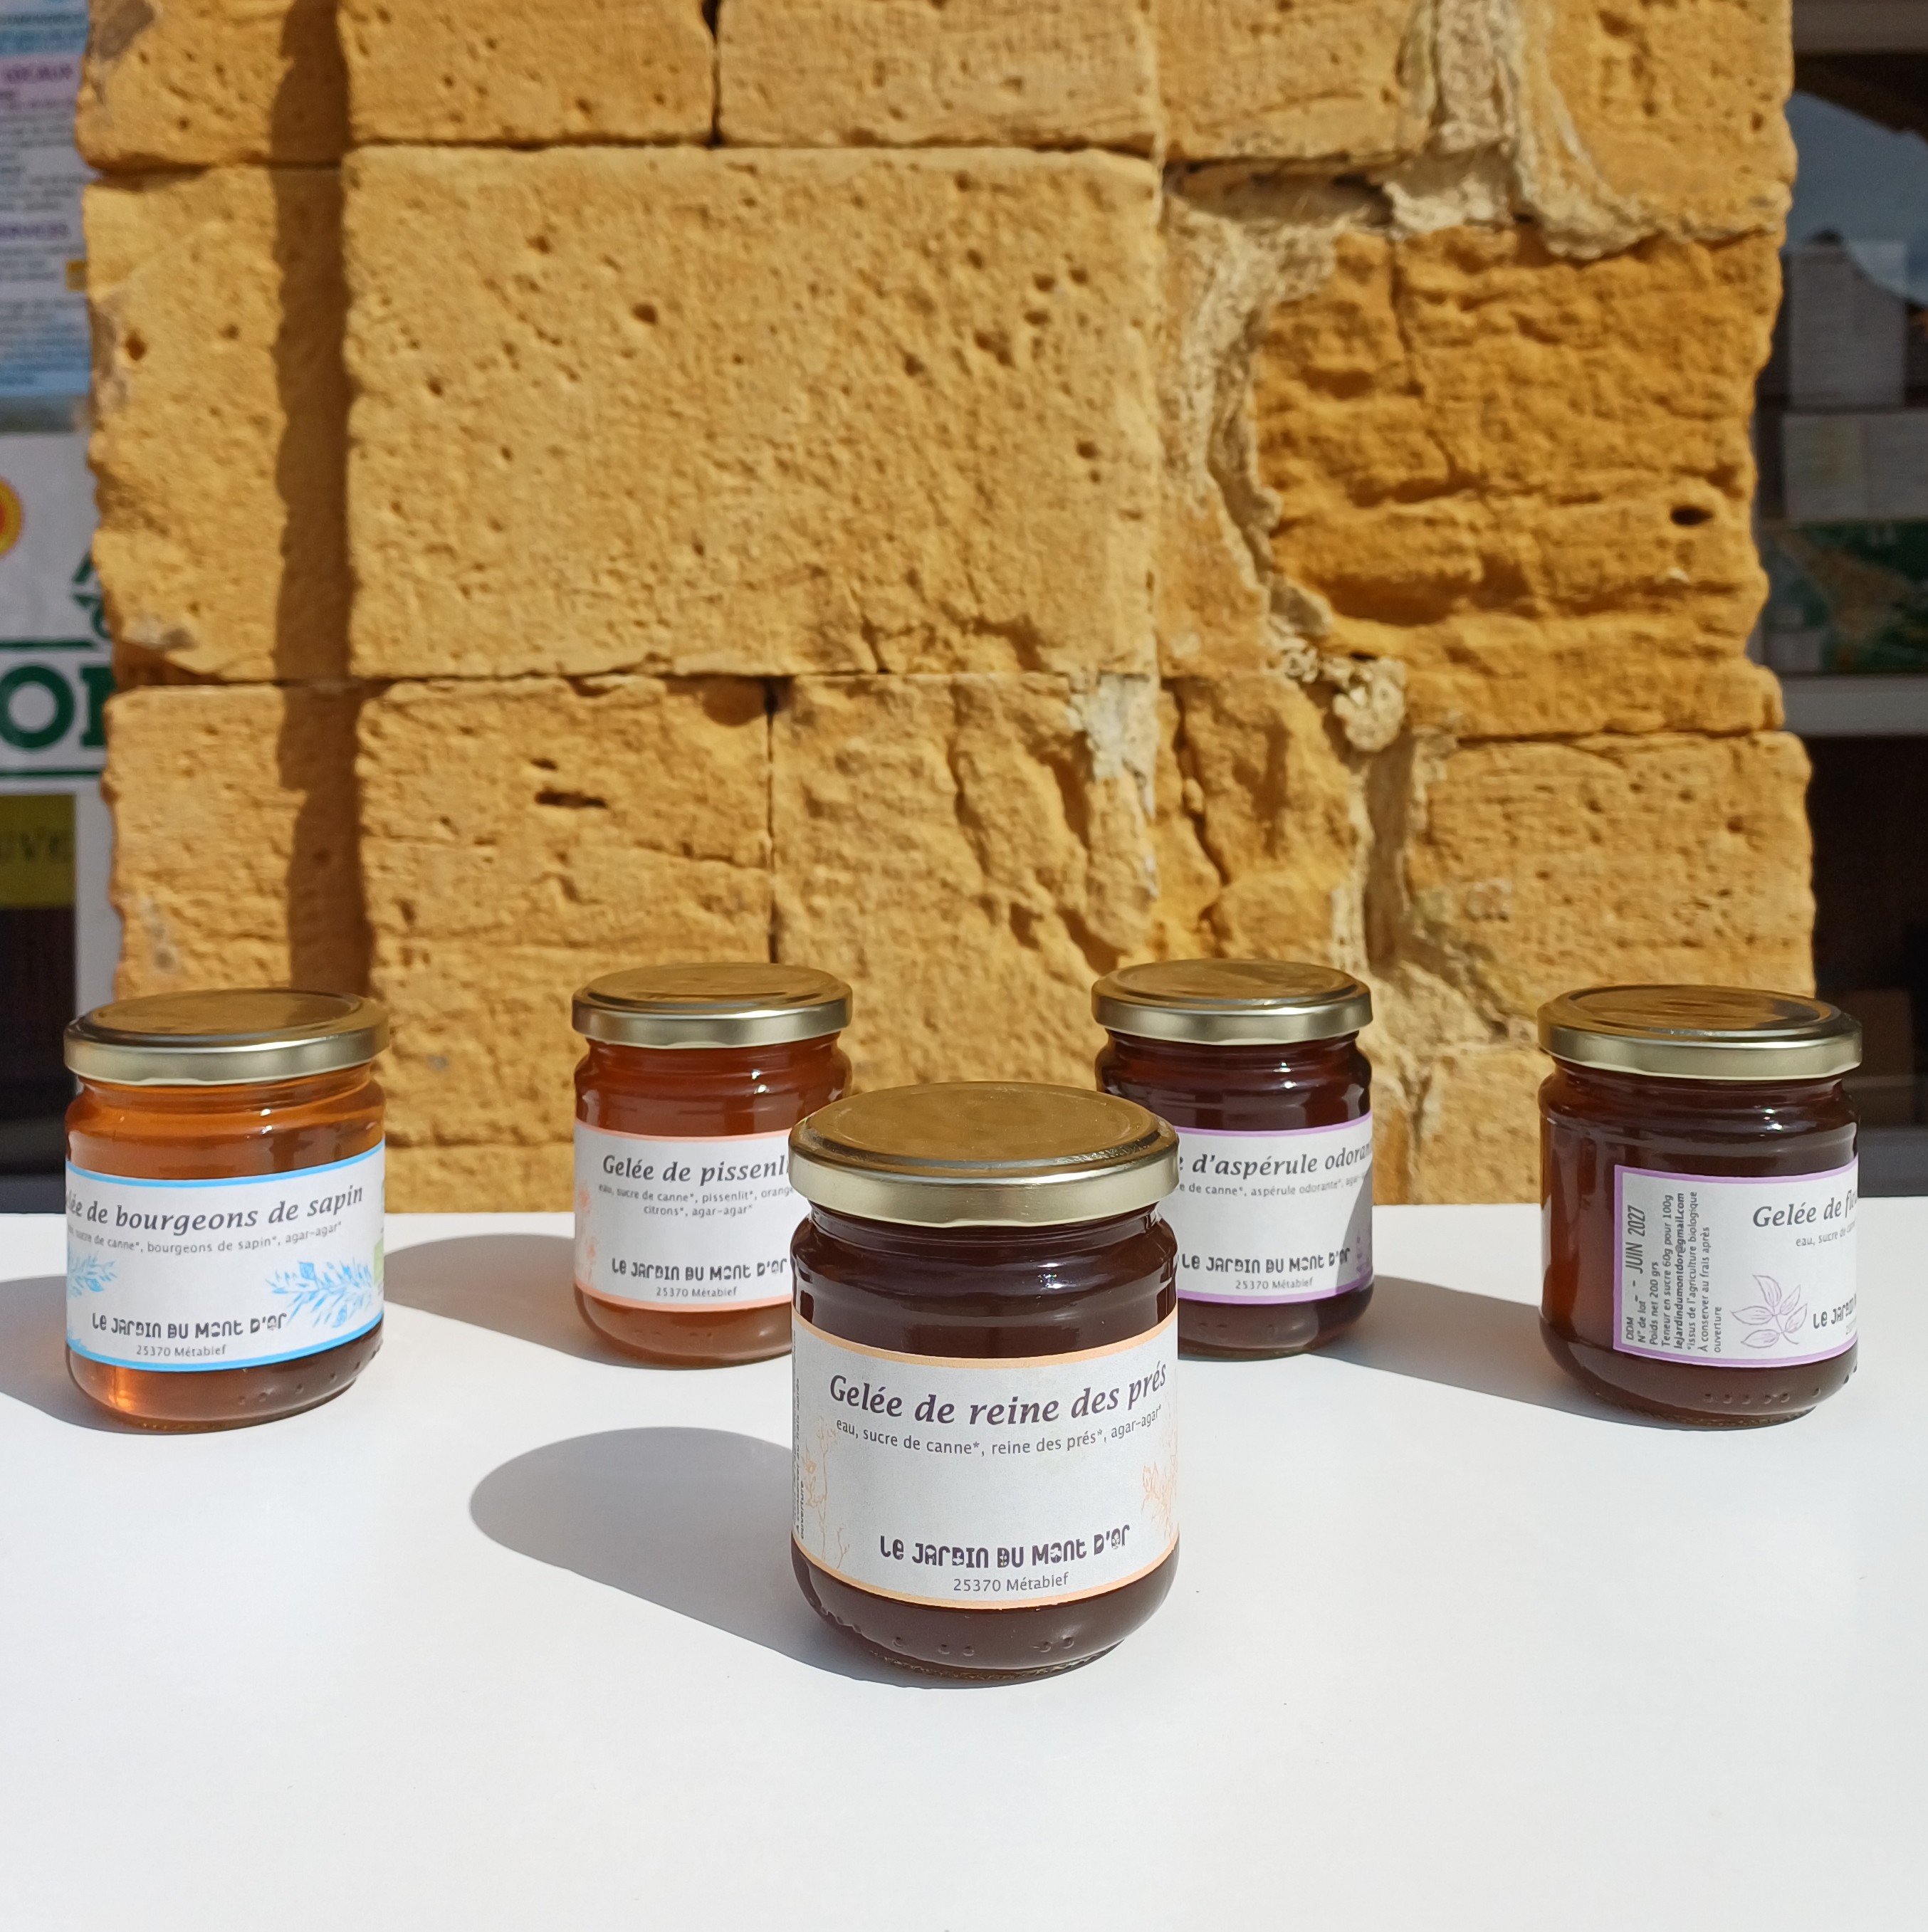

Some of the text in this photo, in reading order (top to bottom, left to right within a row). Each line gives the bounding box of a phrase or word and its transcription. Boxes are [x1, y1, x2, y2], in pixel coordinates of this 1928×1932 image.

[603, 1155, 654, 1182] Gelée
[662, 1162, 691, 1182] de
[1193, 1153, 1318, 1180] d'aspérule
[617, 1187, 639, 1199] sucre
[642, 1188, 654, 1201] de
[1188, 1182, 1202, 1193] de
[1250, 1185, 1296, 1198] aspérule
[87, 1200, 108, 1224] de
[115, 1205, 258, 1236] bourgeons
[268, 1201, 299, 1225] de
[307, 1185, 363, 1217] sapin
[1687, 1191, 1699, 1243] biologique
[1752, 1202, 1817, 1228] Gelée
[1824, 1197, 1842, 1220] de
[147, 1240, 213, 1256] bourgeons
[217, 1240, 233, 1252] de
[1625, 1204, 1645, 1274] JUIN 2027
[1699, 1227, 1712, 1254] après
[1818, 1231, 1838, 1244] sucre
[1650, 1261, 1660, 1277] grs
[1661, 1195, 1674, 1347] Teneur en sucre 60g pour 100g
[1699, 1256, 1710, 1278] frais
[656, 1286, 688, 1298] 25370
[1235, 1279, 1269, 1290] 25370
[1650, 1279, 1659, 1298] 200
[1701, 1281, 1709, 1293] au
[1638, 1316, 1646, 1328] de
[1687, 1307, 1696, 1319] de
[1701, 1295, 1709, 1343] conserver
[1625, 1316, 1634, 1340] DDM
[1650, 1319, 1658, 1345] Poids
[1714, 1306, 1722, 1353] ouverture
[136, 1343, 227, 1357] 25370 Métabief
[830, 1360, 1167, 1426] Gelée de reine des prés
[836, 1418, 859, 1439] eau,
[863, 1428, 898, 1447] sucre
[903, 1434, 921, 1451] de
[992, 1439, 1031, 1455] reine
[1036, 1435, 1062, 1452] des
[953, 1572, 1069, 1592] 25370 Métabief
